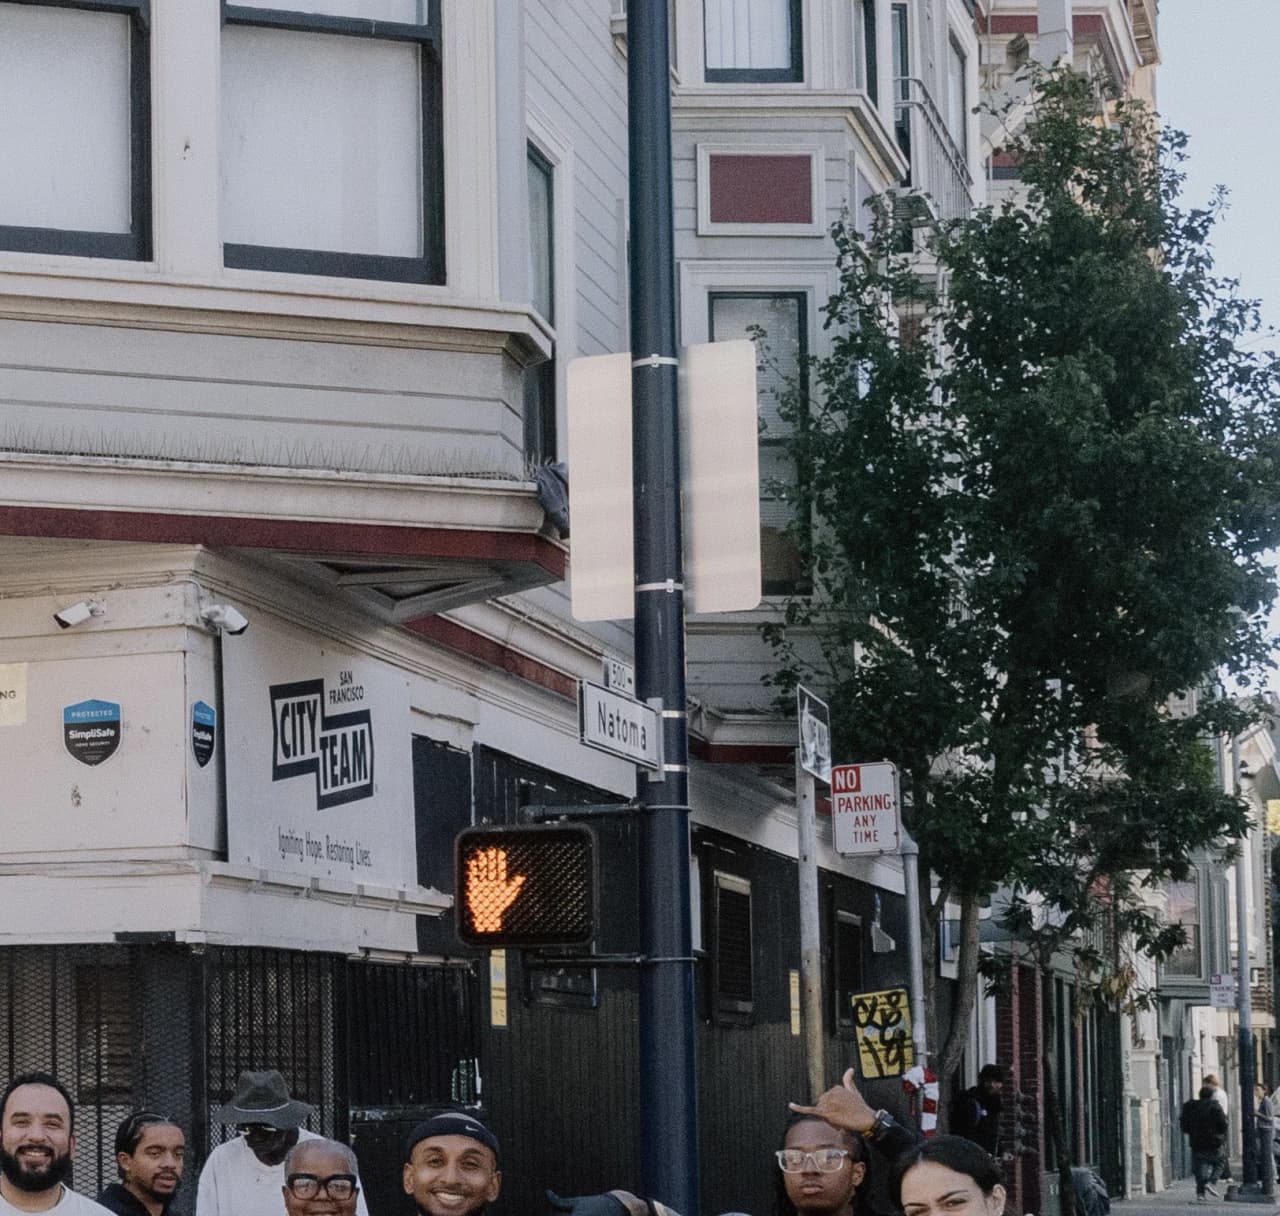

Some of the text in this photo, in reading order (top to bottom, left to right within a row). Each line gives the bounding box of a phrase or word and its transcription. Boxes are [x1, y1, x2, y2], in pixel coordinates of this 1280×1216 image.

[340, 671, 353, 685] SAN
[329, 686, 364, 705] FRANCISCO
[71, 709, 113, 718] PROTECTED
[69, 728, 115, 740] SimpliSafe
[280, 699, 318, 760] CITY
[597, 700, 646, 751] Natoma
[320, 729, 368, 789] TEAM
[835, 769, 857, 791] NO
[838, 793, 892, 813] PARKING
[854, 815, 877, 828] ANY
[853, 831, 879, 843] TIME
[278, 826, 303, 862] Igniting
[326, 834, 354, 870] Restoring
